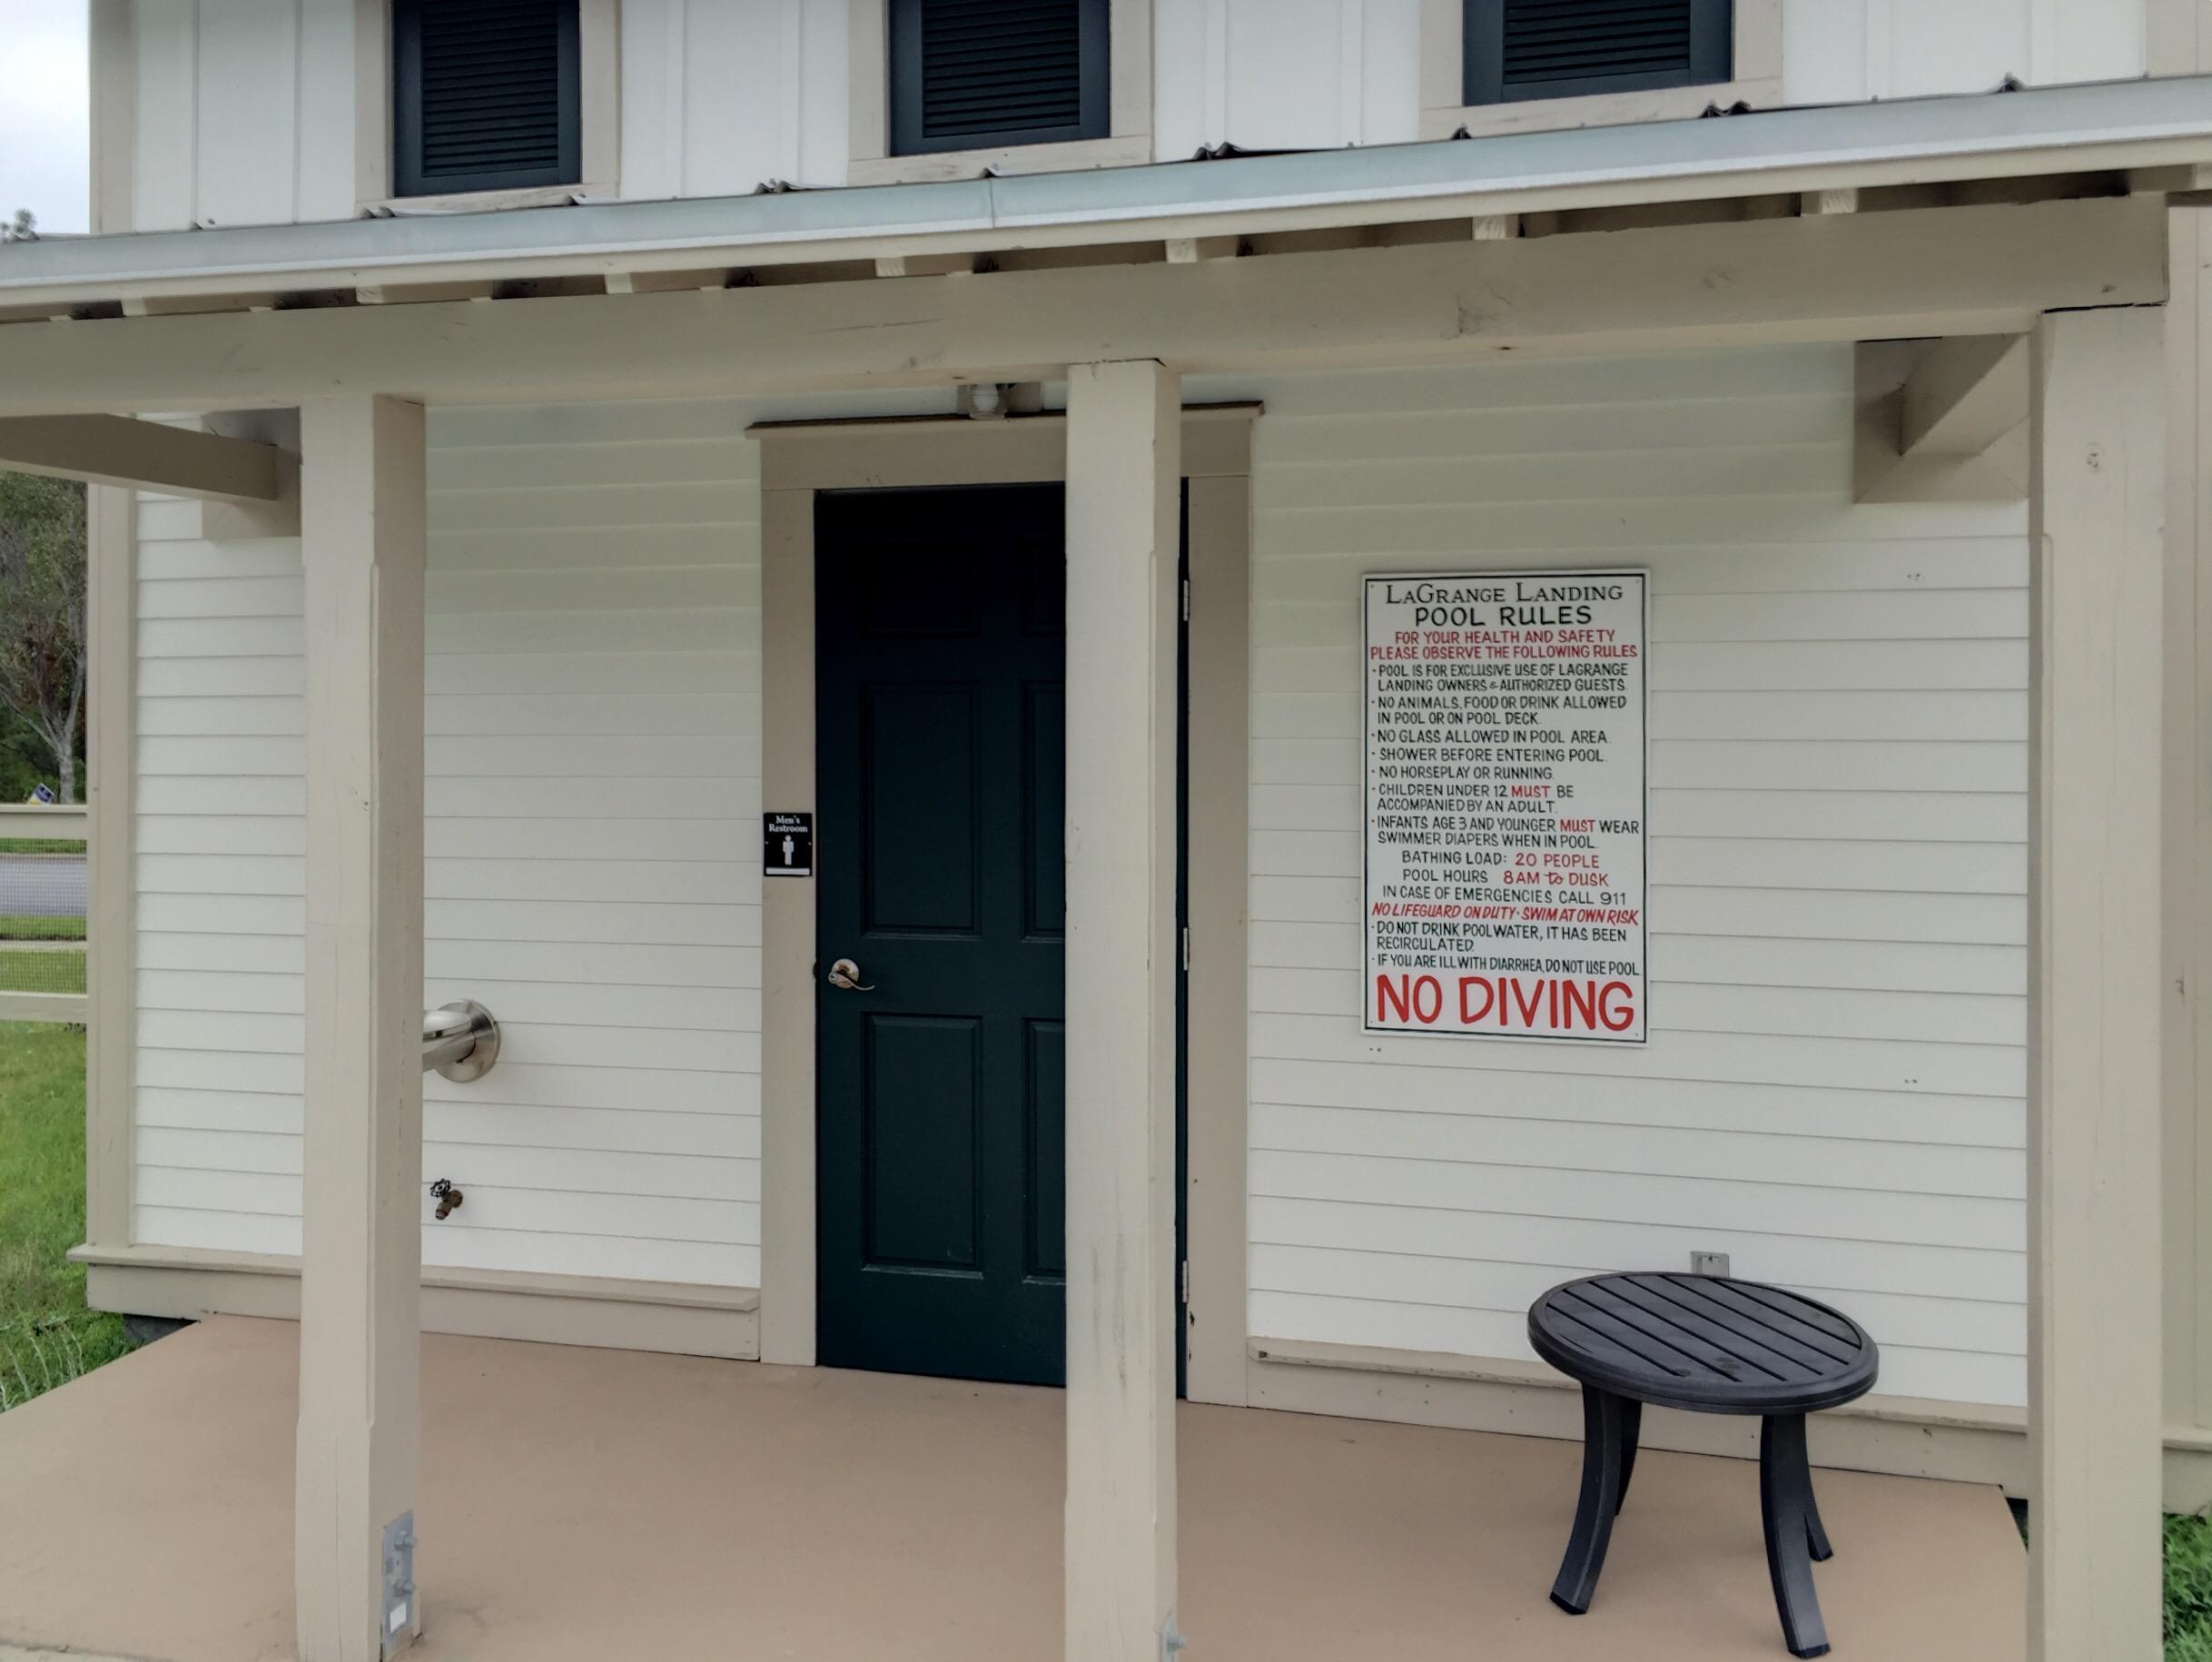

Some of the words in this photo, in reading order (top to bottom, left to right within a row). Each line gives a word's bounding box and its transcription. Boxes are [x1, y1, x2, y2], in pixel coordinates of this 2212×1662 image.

[1416, 608, 1485, 627] POOL
[1500, 606, 1592, 627] RULES
[1395, 632, 1418, 644] FOR
[1424, 632, 1459, 644] YOUR
[1465, 631, 1521, 643] HEALTH
[1525, 630, 1553, 643] AND
[1558, 629, 1615, 643] SAFETY
[1371, 647, 1418, 659] PLEASE
[1423, 647, 1481, 659] OBSERVE
[1486, 646, 1509, 658] THE
[1514, 646, 1590, 658] FOLLOWING
[1594, 645, 1637, 658] RULES
[1378, 665, 1409, 677] POOL
[1412, 665, 1422, 677] IS
[1427, 665, 1447, 677] FOR
[1451, 664, 1511, 677] EXCLUSIVE
[1515, 664, 1537, 676] USE
[1541, 664, 1555, 676] OF
[1559, 663, 1628, 676] LAGRANGE
[1378, 679, 1433, 691] LANDING
[1437, 679, 1486, 691] OWNERS
[1500, 678, 1571, 691] AUTHORIZED
[1378, 697, 1396, 708] NO
[1464, 697, 1498, 708] FOOD
[1502, 697, 1516, 708] OR
[1520, 697, 1558, 708] DRINK
[1564, 696, 1626, 708] ALLOWED
[1378, 713, 1390, 724] IN
[1395, 713, 1425, 724] POOL
[1429, 713, 1445, 724] OR
[1447, 713, 1462, 724] ON
[1467, 713, 1501, 725] POOL
[1378, 731, 1396, 743] NO
[1399, 731, 1441, 743] GLASS
[1446, 730, 1509, 743] ALLOWED
[1514, 731, 1526, 743] IN
[1530, 731, 1565, 743] POOL
[1379, 748, 1437, 761] SHOWER
[1441, 748, 1492, 761] BEFORE
[1497, 748, 1565, 761] ENTERING
[1379, 767, 1397, 778] NO
[1401, 767, 1470, 778] HORSEPLAY
[1474, 767, 1490, 778] OR
[1379, 784, 1443, 796] CHILDREN
[1447, 785, 1489, 796] UNDER
[1494, 785, 1508, 796] 12
[1512, 786, 1551, 797] MUST
[1557, 786, 1574, 797] BE
[1378, 798, 1464, 811] ACCOMPANIED
[1467, 800, 1483, 812] BY
[1486, 800, 1504, 812] AN
[775, 815, 801, 825] Men's
[1378, 816, 1427, 828] INFANTS
[1432, 816, 1457, 829] AGE
[1459, 817, 1467, 829] 3
[1469, 817, 1494, 830] AND
[1497, 817, 1556, 831] YOUNGER
[1560, 819, 1595, 832] MUST
[1599, 820, 1639, 834] WEAR
[769, 823, 808, 833] Restroom
[1378, 832, 1441, 844] SWIMMER
[1446, 833, 1498, 846] DIAPERS
[1502, 835, 1540, 846] WHEN
[1545, 836, 1556, 846] IN
[1402, 851, 1462, 864] BATHING
[1515, 854, 1537, 866] 20
[1544, 854, 1599, 868] PEOPLE
[1403, 870, 1437, 881] POOL
[1444, 870, 1488, 883] HOURS
[1504, 871, 1539, 885] 8AM
[1569, 873, 1608, 886] DUSK
[1383, 886, 1397, 897] IN
[1400, 886, 1430, 899] CASE
[1435, 887, 1451, 899] OF
[1456, 889, 1553, 903] EMERGENCIES
[1559, 891, 1594, 904] CALL
[1600, 892, 1625, 905] 911
[1372, 903, 1390, 915] NO
[1392, 904, 1460, 916] LIFEGUARD
[1464, 905, 1481, 917] ON
[1483, 906, 1516, 918] DUTY
[1521, 908, 1557, 921] SWIM
[1559, 909, 1576, 922] AT
[1577, 909, 1604, 923] OWN
[1606, 910, 1638, 925] RISK
[1378, 922, 1394, 934] DO
[1397, 922, 1417, 935] NOT
[1422, 924, 1459, 935] DRINK
[1463, 925, 1492, 936] POOL
[1547, 927, 1557, 938] IT
[1562, 927, 1588, 940] HAS
[1593, 928, 1626, 942] BEEN
[1378, 955, 1387, 965] IF
[1391, 955, 1412, 966] YOU
[1414, 955, 1437, 966] ARE
[1439, 955, 1457, 967] ILL
[1458, 956, 1486, 969] WITH
[1545, 960, 1562, 972] DO
[1564, 961, 1584, 974] NOT
[1586, 961, 1605, 974] USE
[1377, 974, 1442, 1024] NO
[1459, 976, 1634, 1031] DIVING
